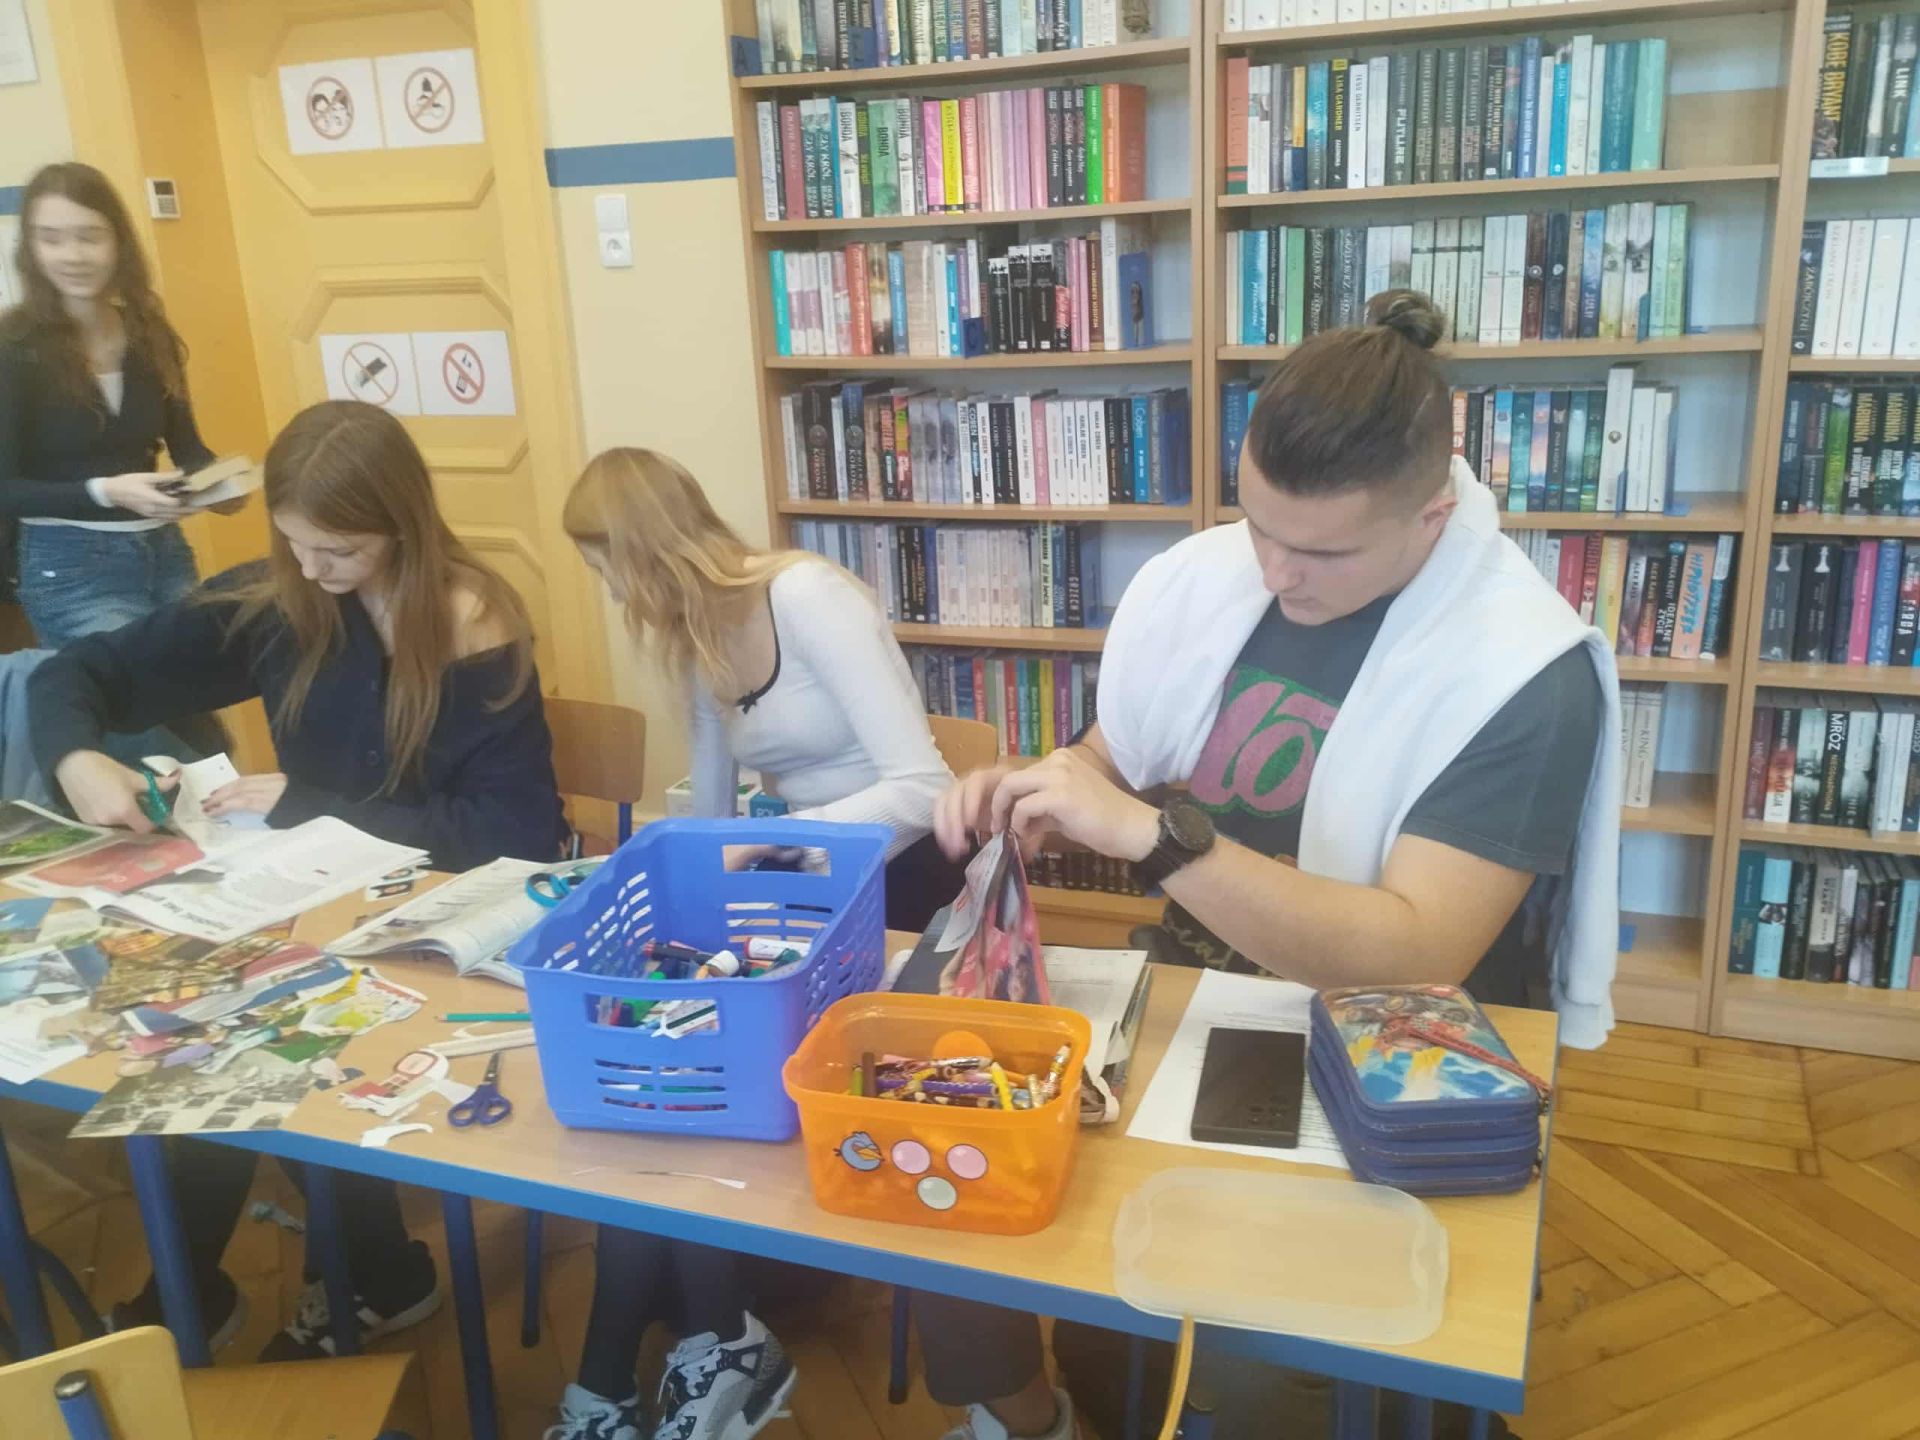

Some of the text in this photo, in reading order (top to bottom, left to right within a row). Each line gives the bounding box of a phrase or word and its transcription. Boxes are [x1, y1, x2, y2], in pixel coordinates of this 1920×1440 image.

[1824, 33, 1851, 69] KOBE
[1821, 71, 1846, 122] BRYANT
[1891, 67, 1910, 99] LINK
[839, 111, 853, 142] BONDA
[1334, 94, 1343, 131] GARDNER
[877, 126, 890, 158] BONDA
[1395, 108, 1407, 164] FUTURE
[1799, 266, 1817, 331] ZABÓJCZYNI
[969, 407, 978, 436] COBEN
[1134, 407, 1147, 439] Coben
[1853, 392, 1874, 443] MARININA
[1883, 392, 1905, 443] MARININA
[812, 448, 823, 490] KORONA
[848, 449, 859, 492] KORONA
[1067, 576, 1081, 611] GRZECH
[1665, 554, 1680, 600] MINKA KENT
[1679, 552, 1705, 635] HIPNOTYZER
[1661, 602, 1677, 643] IDEALNE
[1637, 729, 1651, 760] KING
[1827, 713, 1846, 751] MRÓZ
